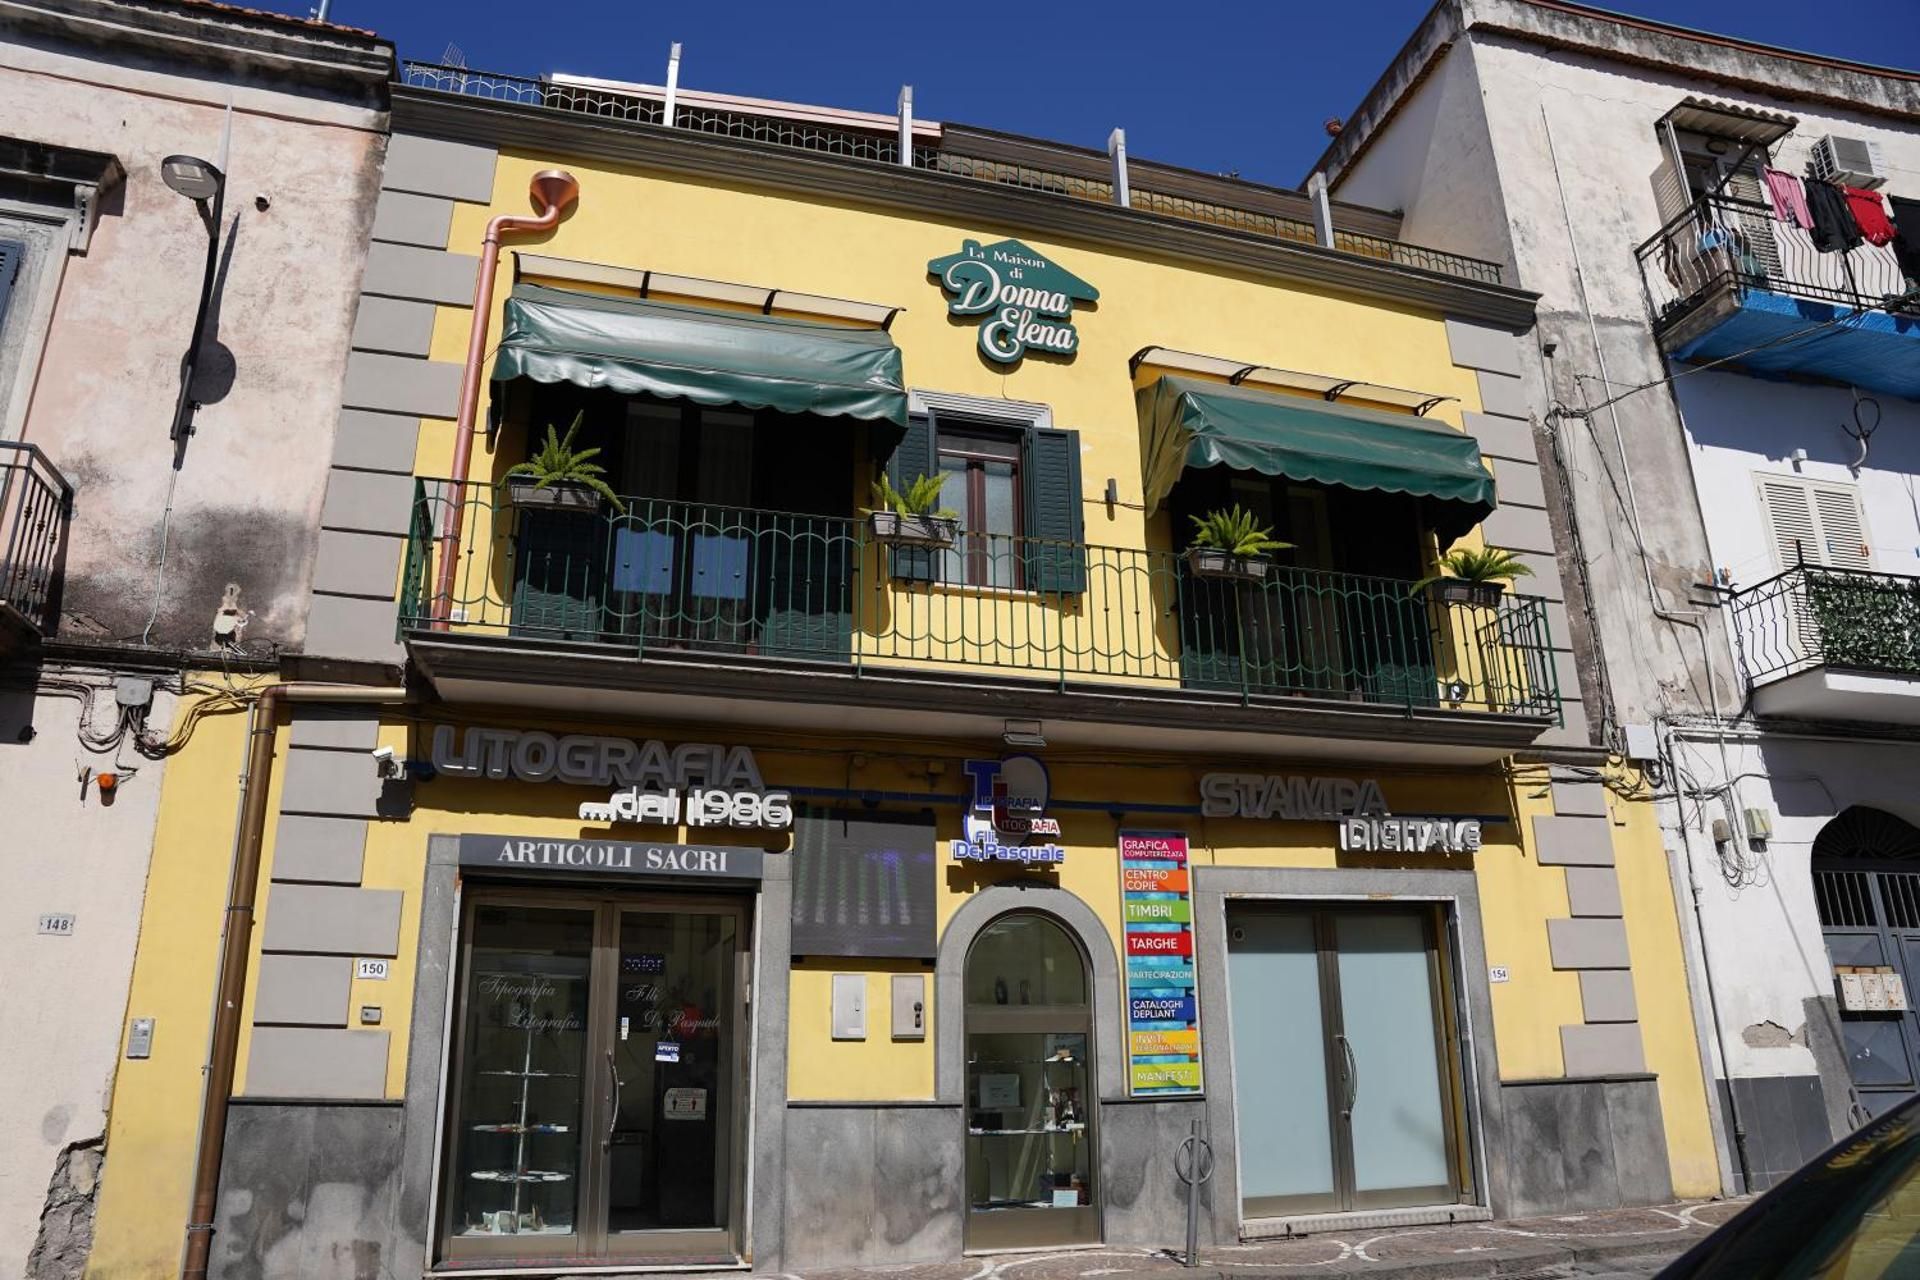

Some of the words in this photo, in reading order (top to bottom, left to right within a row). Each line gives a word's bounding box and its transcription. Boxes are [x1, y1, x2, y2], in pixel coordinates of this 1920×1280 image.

[969, 247, 985, 259] La
[993, 251, 1046, 269] Maison
[1009, 267, 1023, 279] di
[946, 260, 1069, 313] Donna
[983, 307, 1074, 358] Elena
[433, 726, 765, 788] LITOGRAFIA
[1202, 773, 1390, 818] STAMPA
[612, 786, 679, 823] dal
[689, 789, 792, 827] 1986
[1342, 816, 1482, 851] DIGITALE
[1124, 840, 1169, 850] GRAFICA
[497, 840, 632, 868] ARTICOLI
[645, 849, 728, 873] SACRI
[954, 842, 980, 860] De
[984, 844, 1065, 864] Pasquale
[1125, 869, 1168, 880] CENTRO
[1126, 880, 1158, 890] COPIE
[1128, 904, 1172, 918] TIMBRI
[46, 919, 69, 931] 148
[1131, 937, 1178, 950] TARGHE
[361, 963, 384, 974] 150
[1492, 969, 1506, 978] 154
[1132, 1000, 1184, 1009] CATALOGHI
[1133, 1009, 1176, 1019] DEPLIANT
